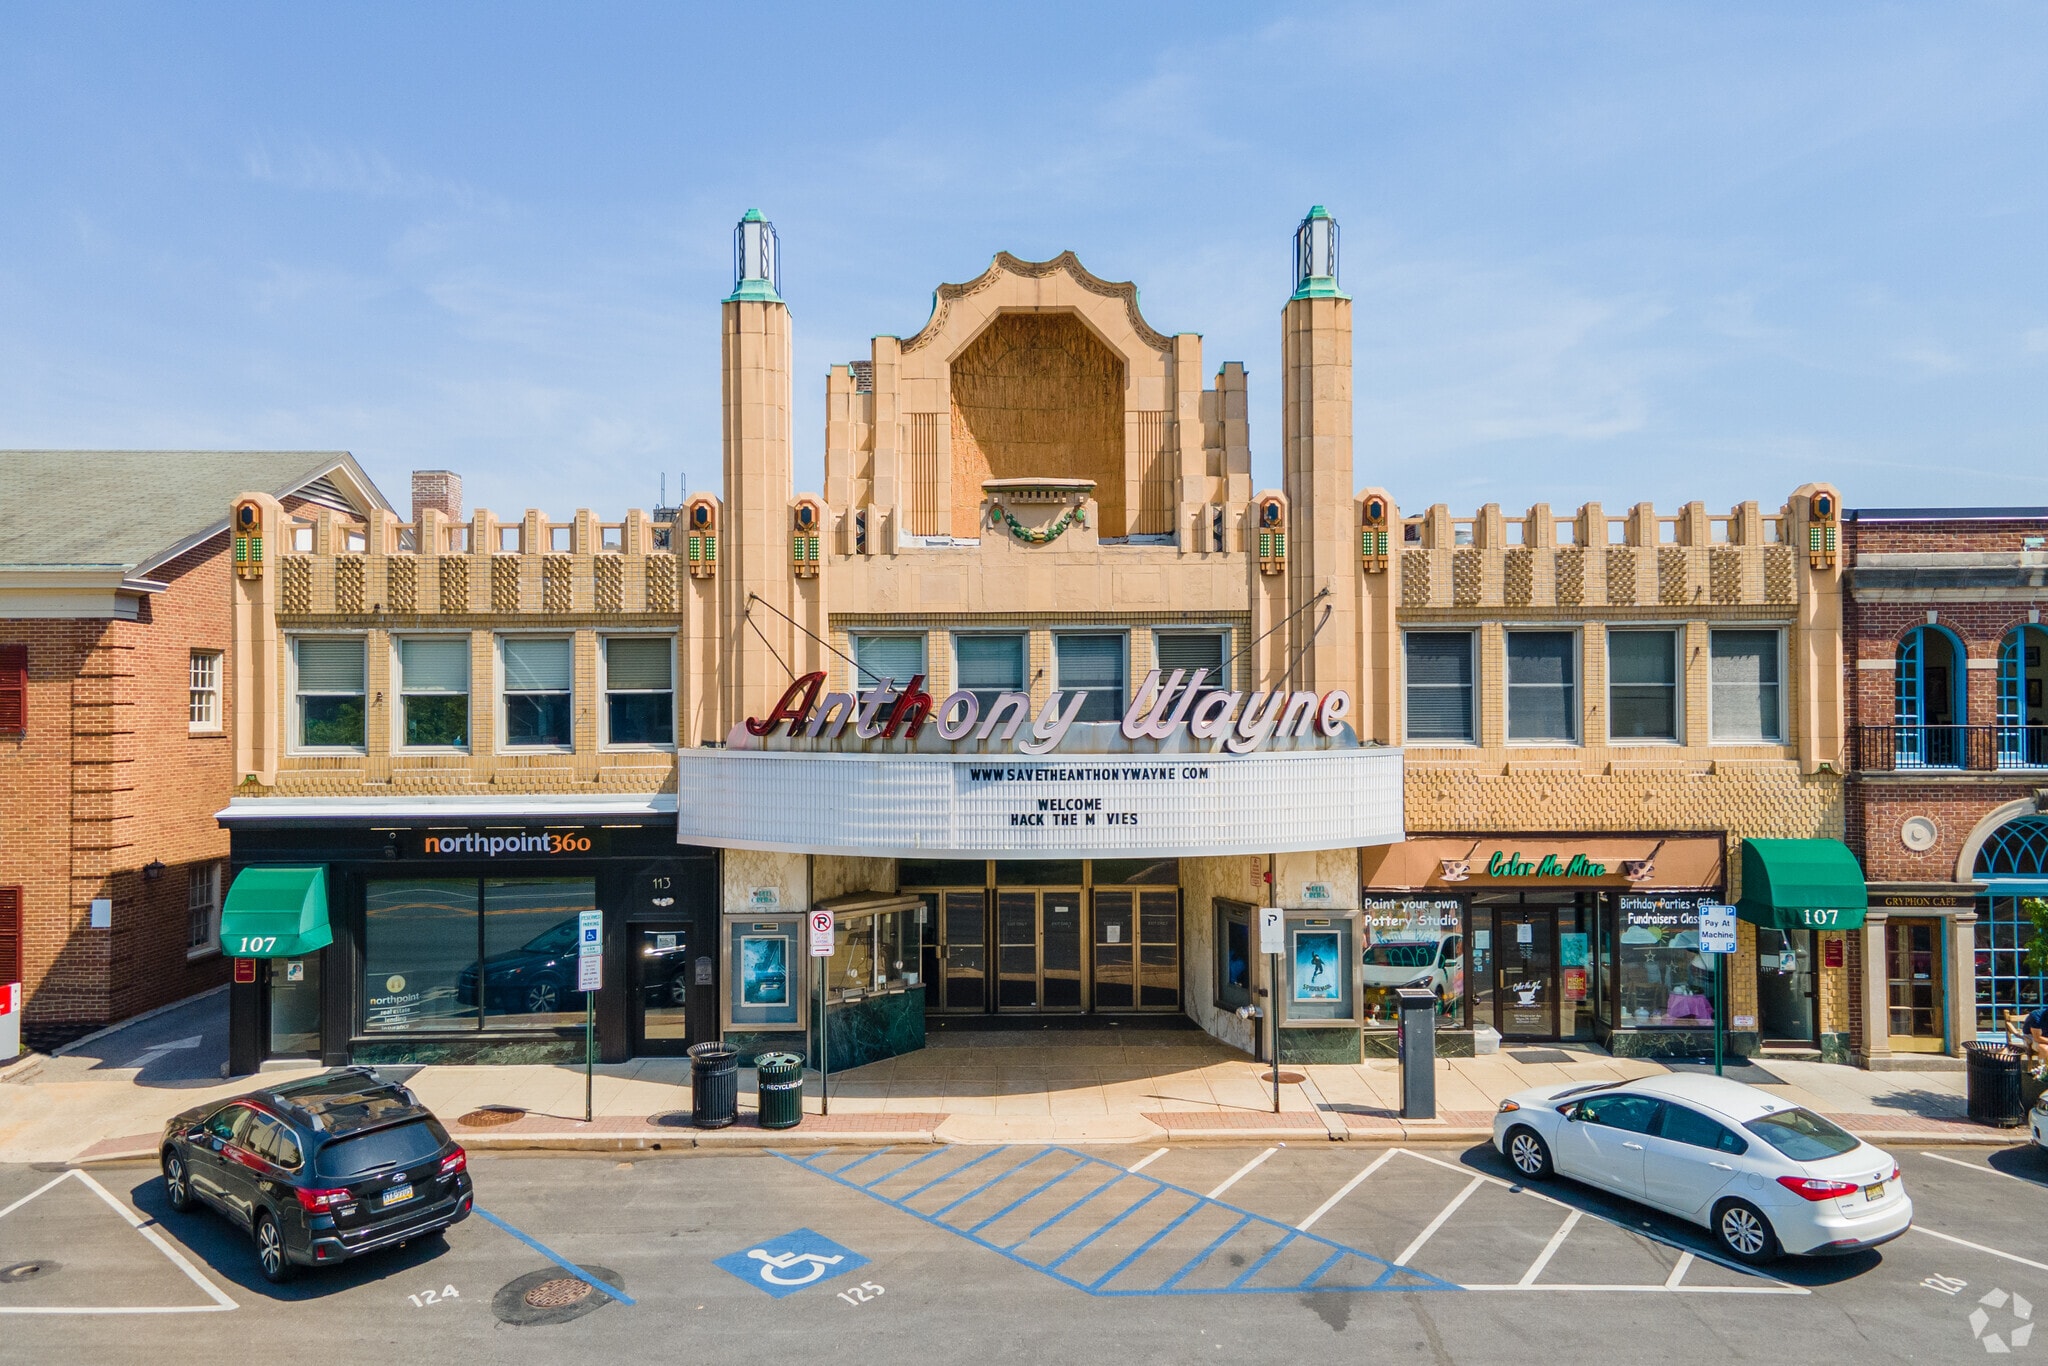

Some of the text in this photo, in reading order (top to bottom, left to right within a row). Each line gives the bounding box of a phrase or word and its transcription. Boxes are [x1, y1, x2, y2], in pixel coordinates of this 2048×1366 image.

[745, 668, 1351, 755] Anthony Wayne
[1182, 767, 1209, 780] COM
[1038, 798, 1102, 811] WELCOME
[1010, 813, 1044, 826] HACK
[1053, 813, 1078, 826] THE
[425, 832, 592, 857] northpoint360
[1488, 851, 1606, 878] Color Me Mine
[652, 877, 671, 889] 113
[1364, 898, 1395, 910] Paint
[1402, 900, 1431, 912] your
[1434, 900, 1458, 910] own
[1620, 898, 1657, 912] Birthday
[1660, 898, 1691, 909] Parties
[1885, 897, 1957, 906] GRYPHON CAFE
[1364, 914, 1458, 928] Pottery Studio
[1628, 912, 1700, 924] Fundraisers Clas
[1705, 919, 1730, 928] Pay At
[1803, 909, 1839, 925] 107
[1702, 931, 1734, 939] Machine
[239, 936, 277, 953] 107
[370, 993, 420, 1005] northpoint
[766, 1082, 798, 1090] RECYCLING
[1920, 1273, 1968, 1295] 126
[407, 1284, 460, 1307] 124
[837, 1281, 885, 1305] 125
